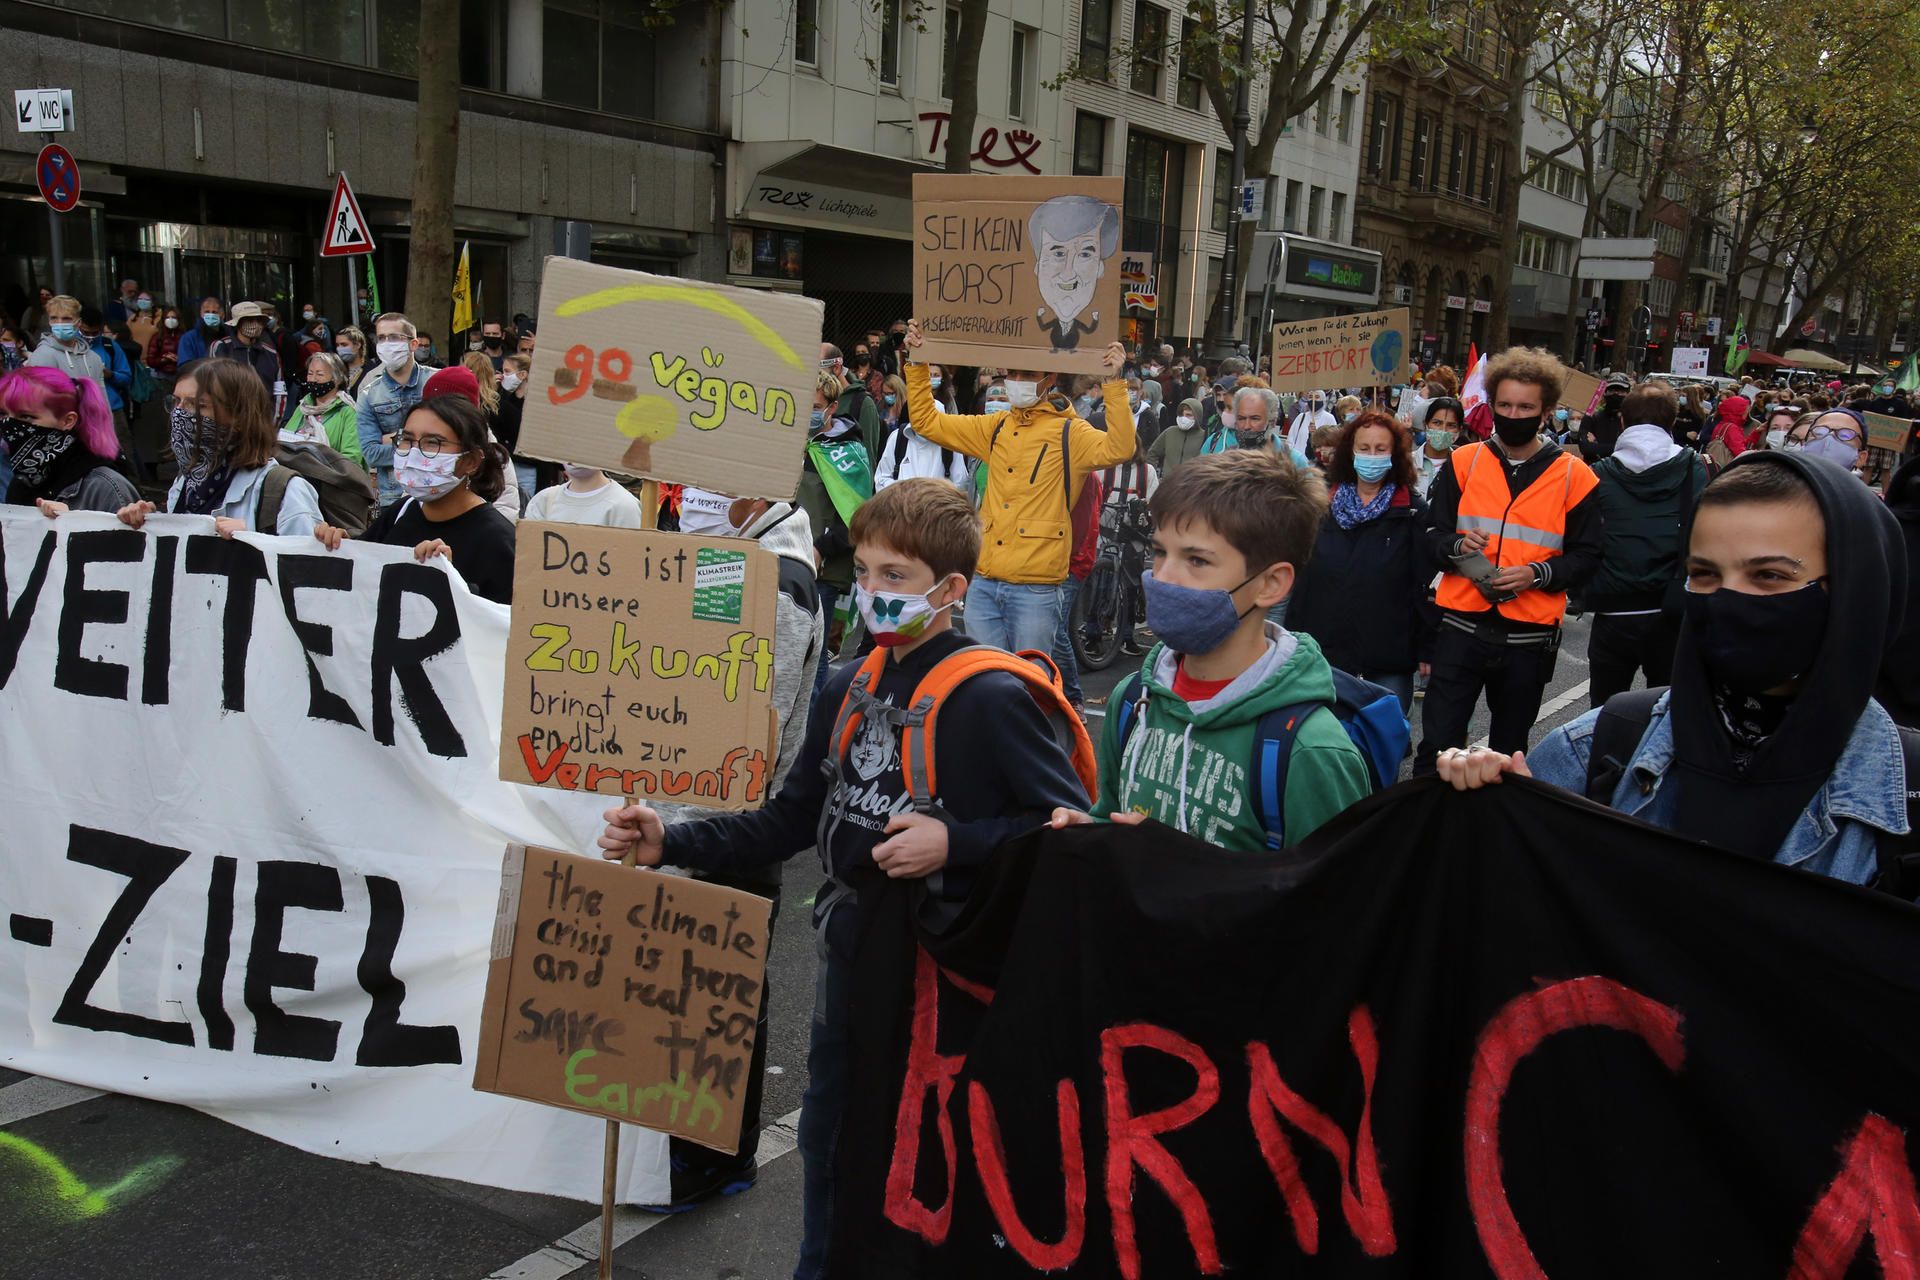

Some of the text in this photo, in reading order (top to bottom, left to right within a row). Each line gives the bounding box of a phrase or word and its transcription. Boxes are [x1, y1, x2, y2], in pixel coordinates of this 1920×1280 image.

[39, 100, 59, 119] WC
[818, 198, 879, 218] Lichtspiele
[921, 215, 1023, 252] SEI KEIN
[925, 261, 1025, 305] HORST
[1121, 256, 1144, 273] dm
[1279, 325, 1318, 337] Warum
[1336, 318, 1348, 329] die
[1352, 315, 1389, 328] Zukunft
[1308, 336, 1332, 346] wenn
[1358, 331, 1371, 342] sie
[1278, 344, 1370, 376] ZERSTÖRT
[547, 344, 796, 431] go vegan
[543, 530, 687, 584] Das ist
[697, 564, 743, 577] KLIMASTREIK
[543, 590, 641, 617] unsere
[525, 620, 775, 703] Zukunft
[530, 675, 688, 733] bringt euch
[517, 733, 767, 802] Vernunft
[531, 720, 687, 764] endlich zur
[543, 859, 757, 960] the climate
[9, 824, 463, 1067] -ZIEL
[537, 917, 759, 1008] crisis is here
[533, 953, 604, 988] and
[624, 977, 690, 1017] real
[655, 1021, 745, 1098] the
[564, 1048, 724, 1133] Earth
[883, 942, 1396, 1280] BURN
